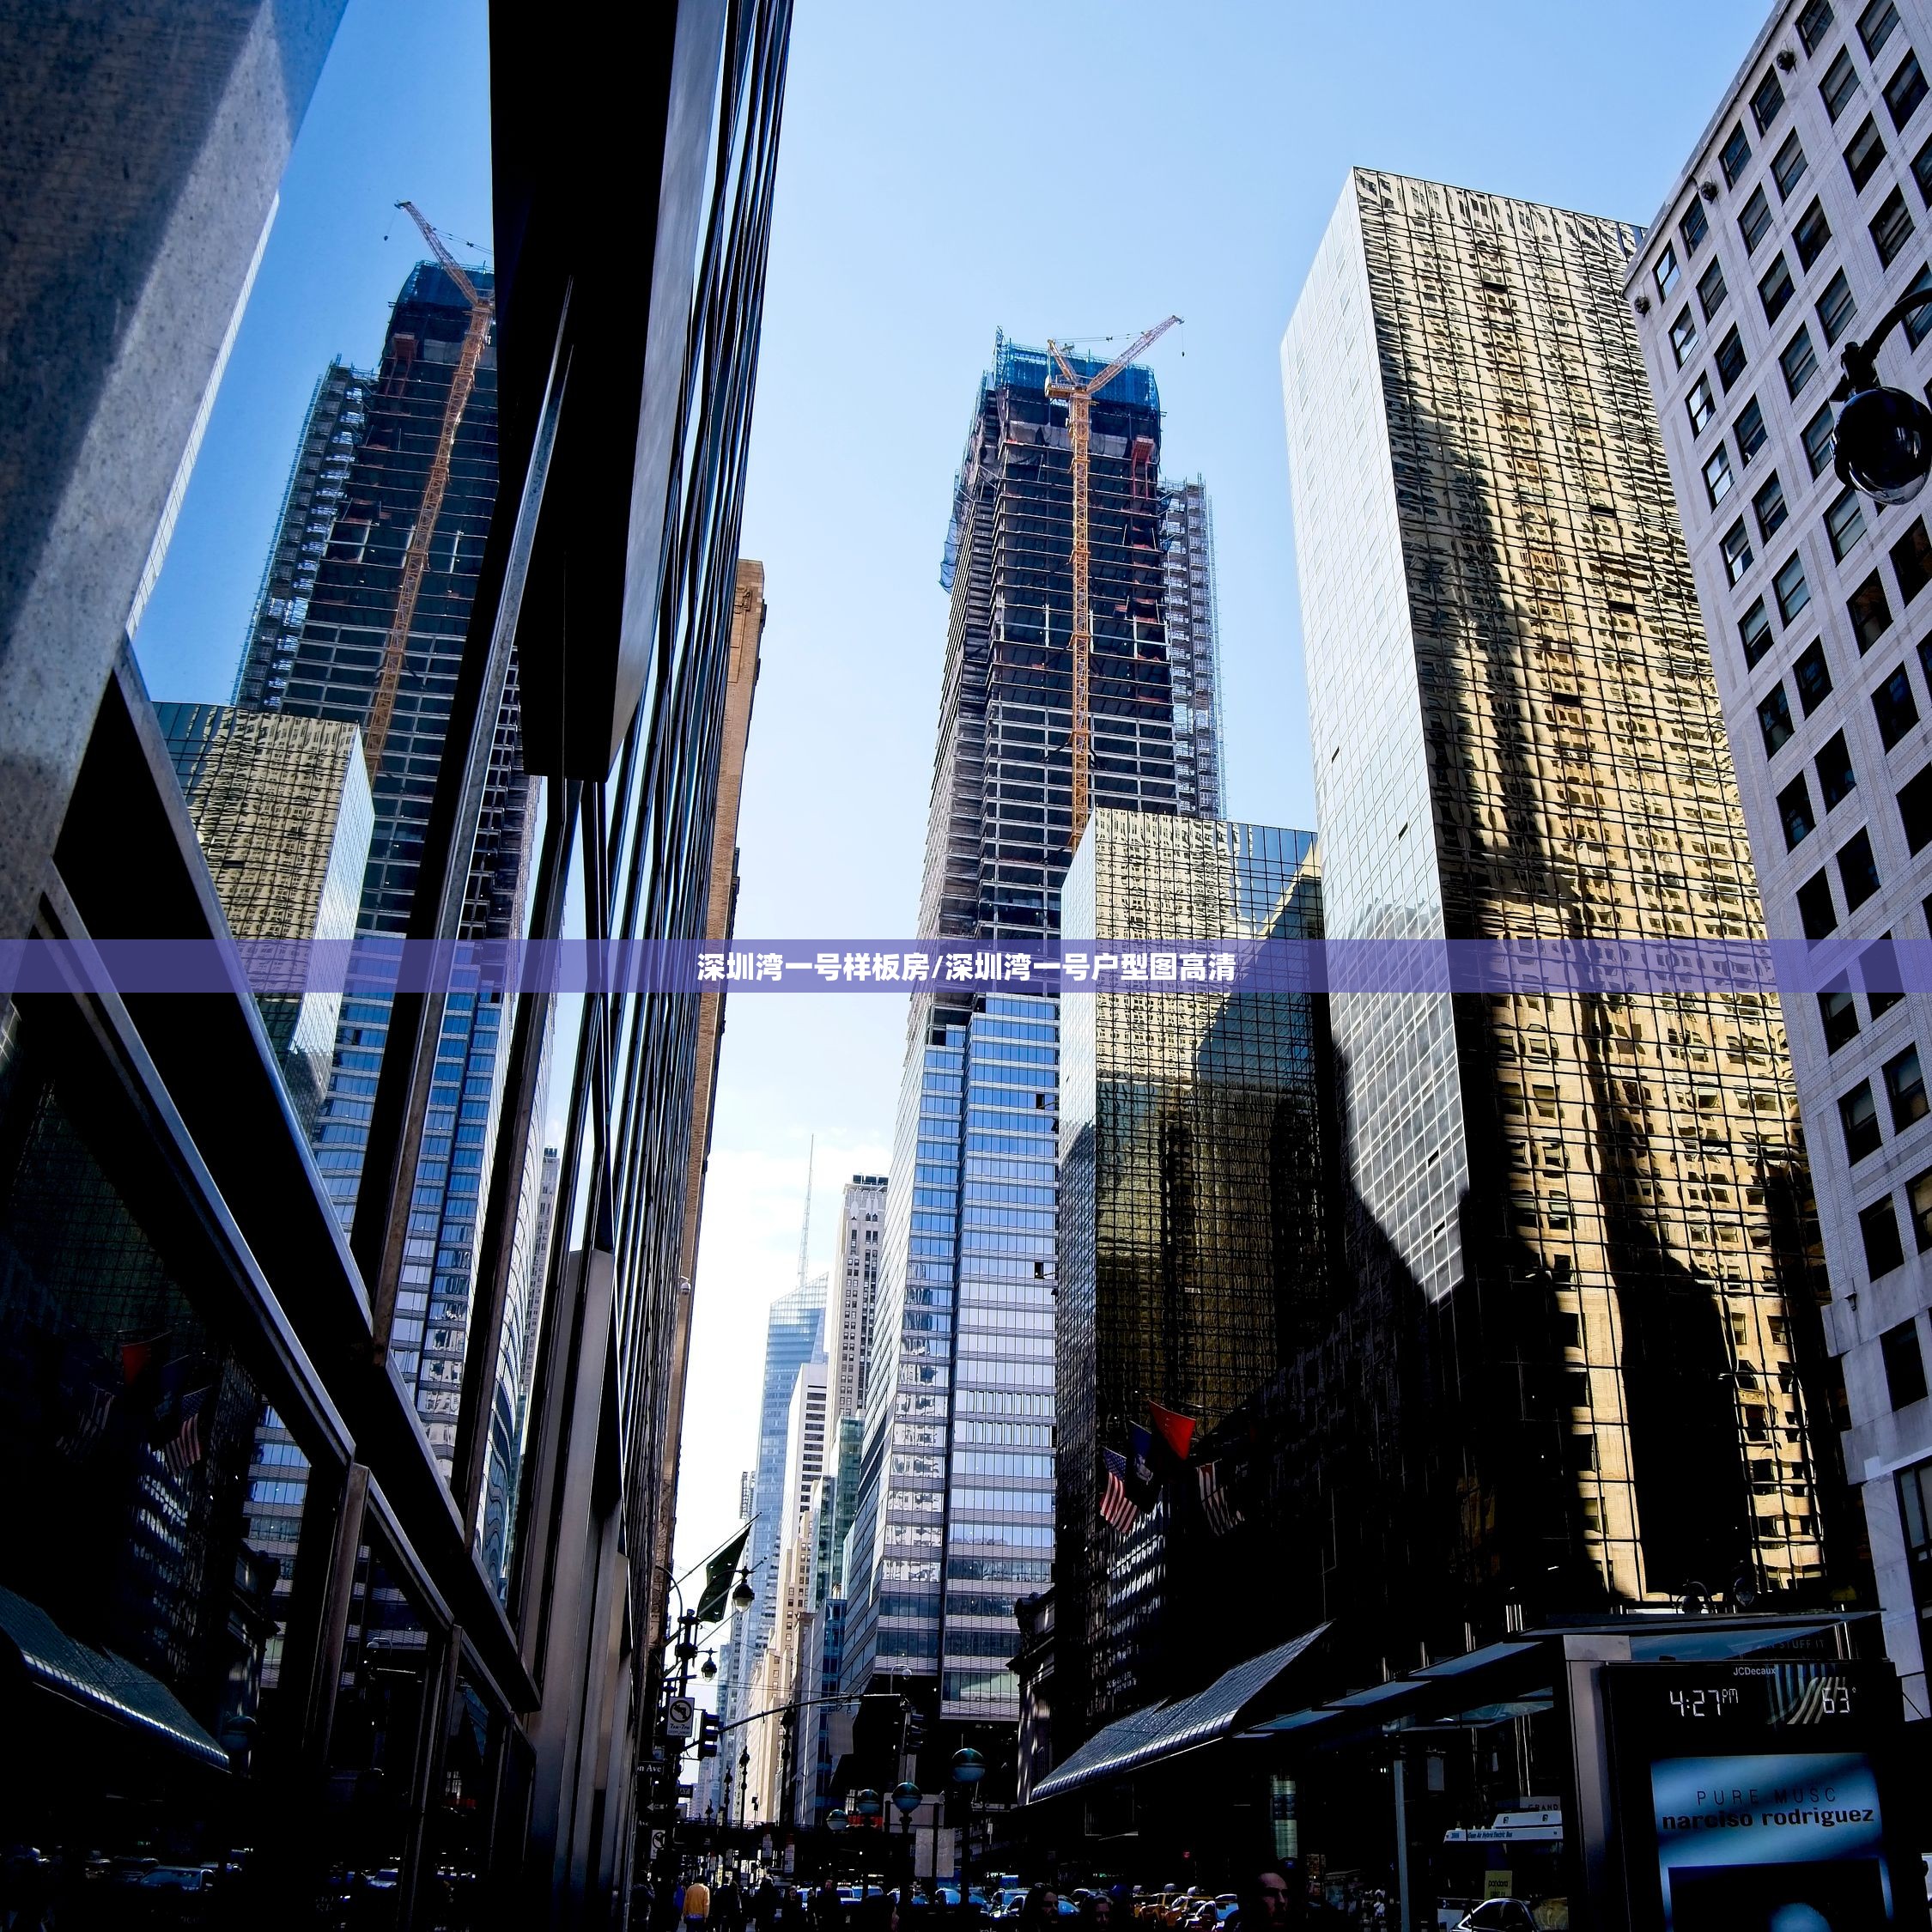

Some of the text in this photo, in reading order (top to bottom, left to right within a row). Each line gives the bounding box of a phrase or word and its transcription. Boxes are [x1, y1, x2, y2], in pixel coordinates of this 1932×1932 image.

[1733, 1667, 1777, 1676] JCDecaux
[1697, 1787, 1836, 1806] PURE MUSC
[1662, 1807, 1874, 1830] narciso rodriguez
